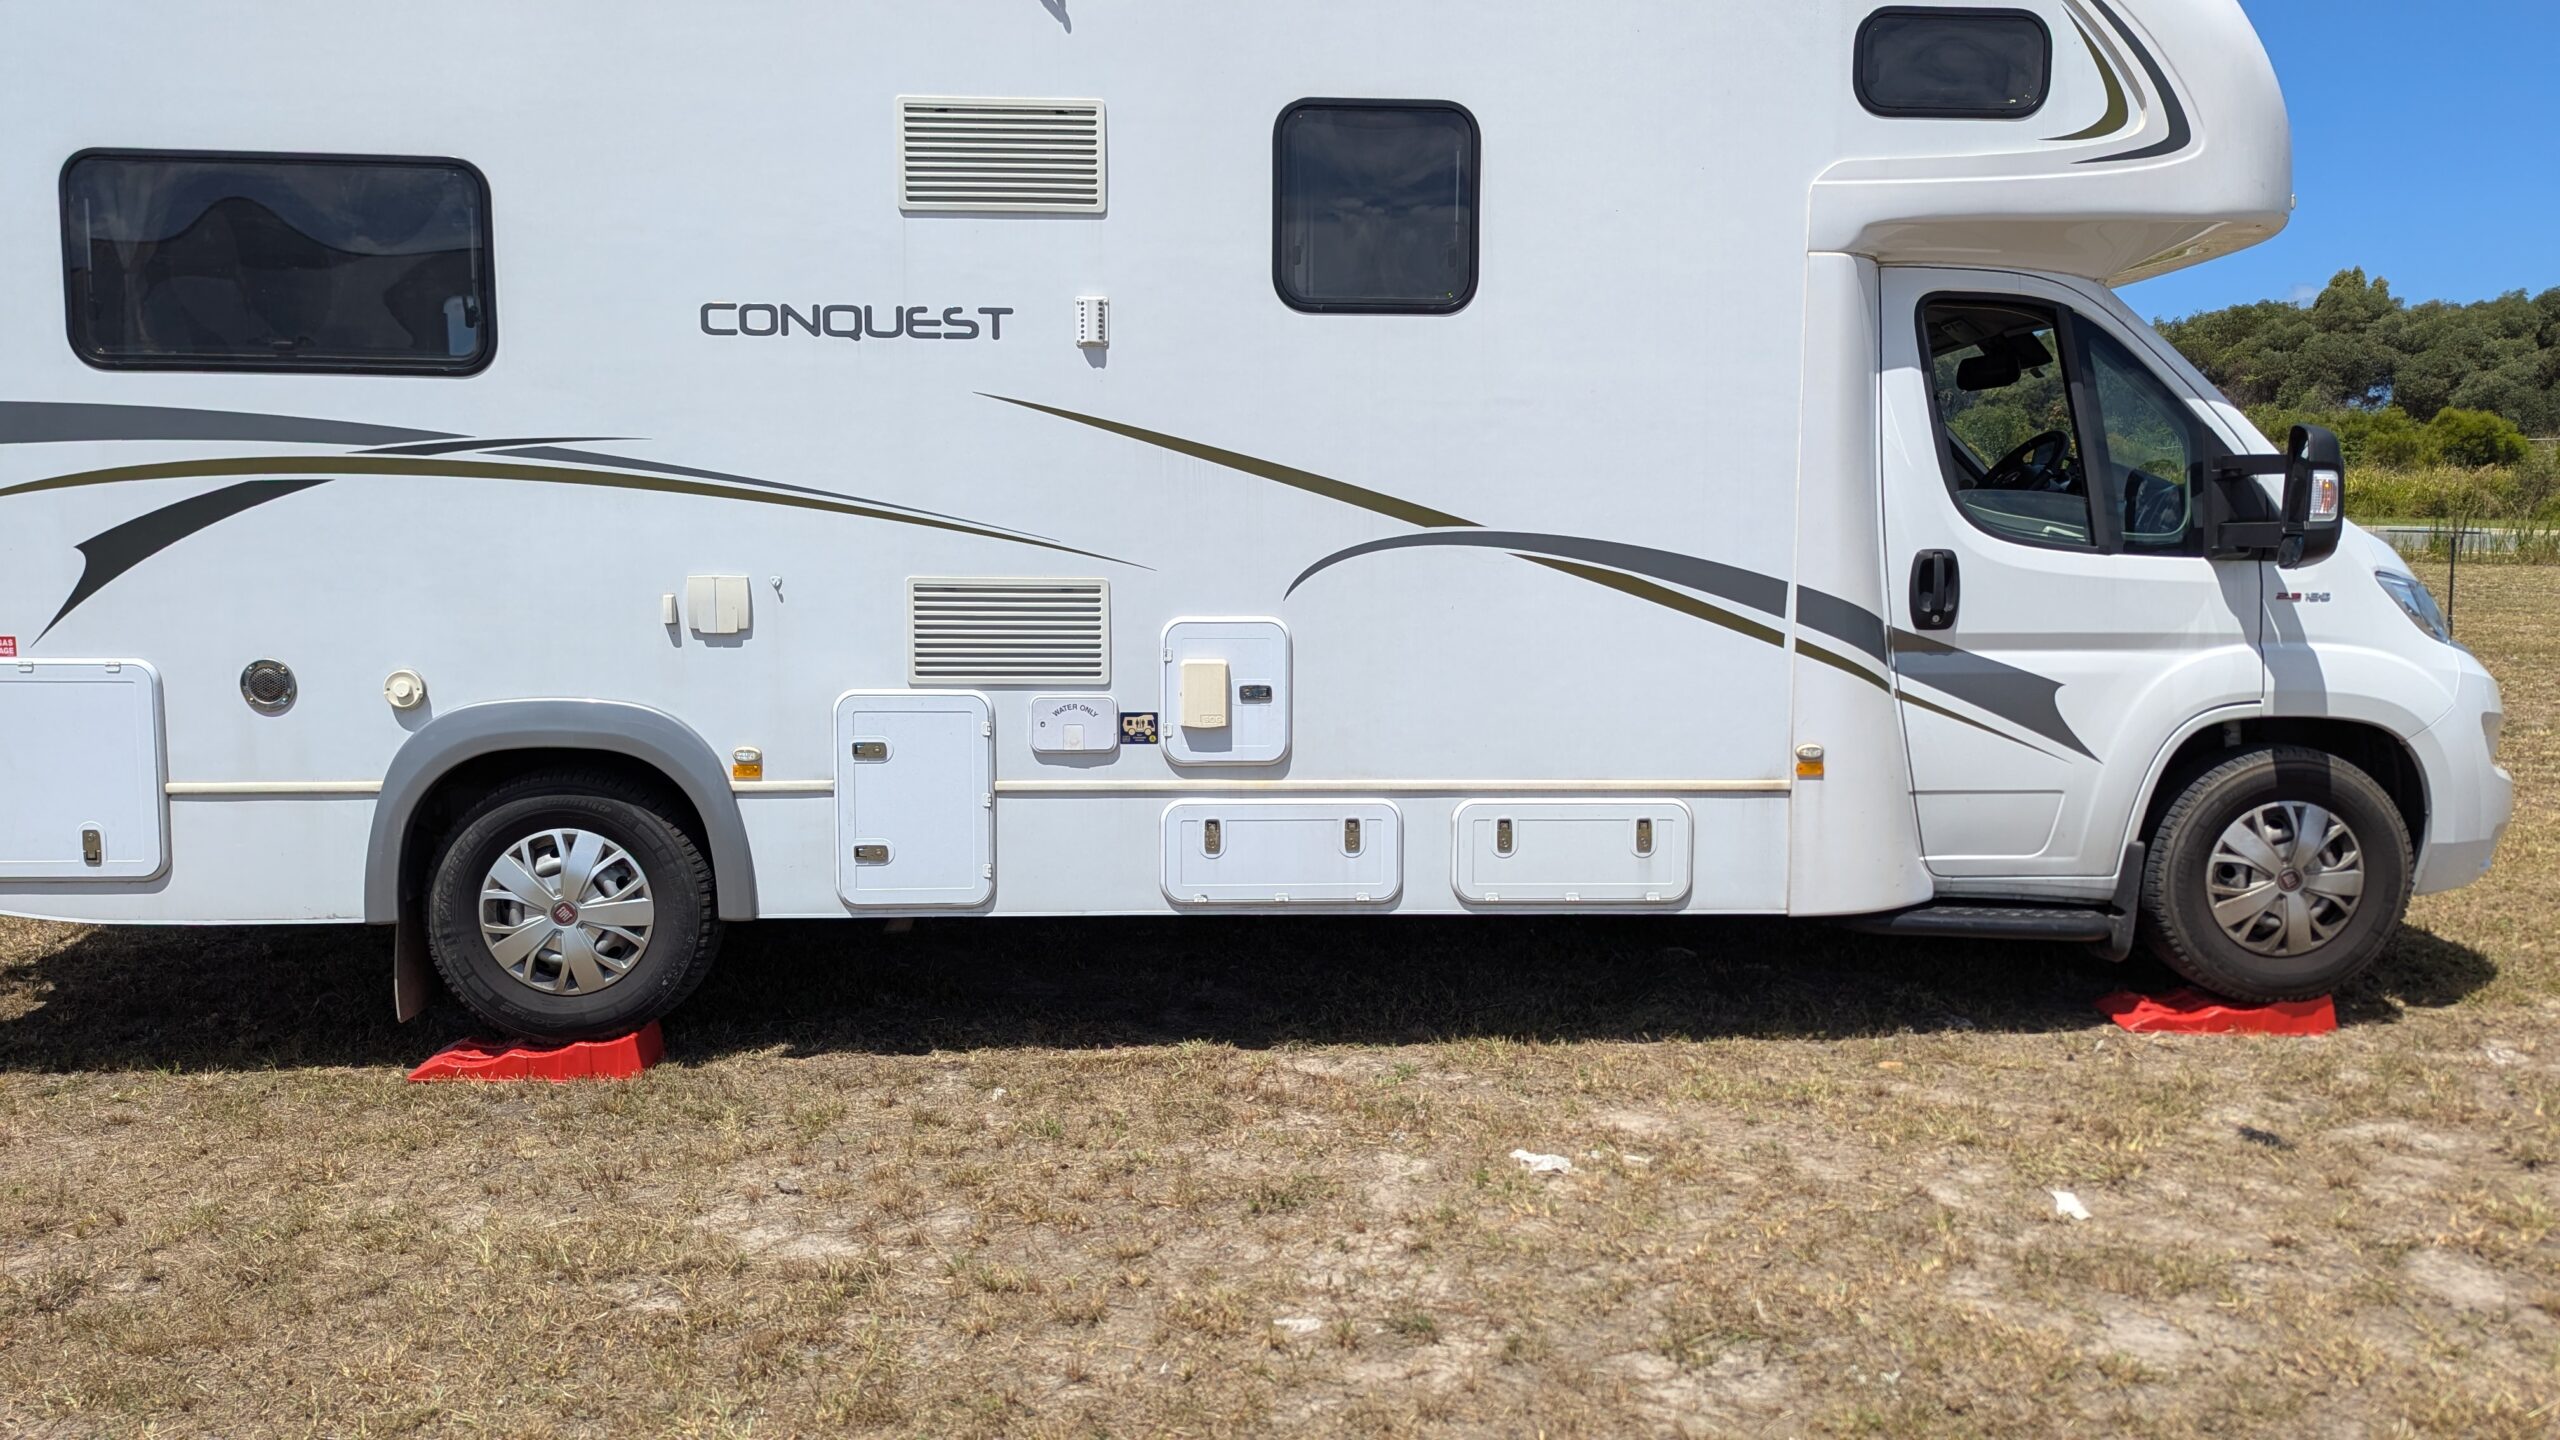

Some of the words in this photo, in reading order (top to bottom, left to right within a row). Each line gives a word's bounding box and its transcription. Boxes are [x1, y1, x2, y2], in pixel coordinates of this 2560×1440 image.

[700, 302, 1014, 341] CONQUEST
[1052, 703, 1078, 716] WATER
[1079, 704, 1099, 717] ONLY
[556, 906, 573, 921] FIAT
